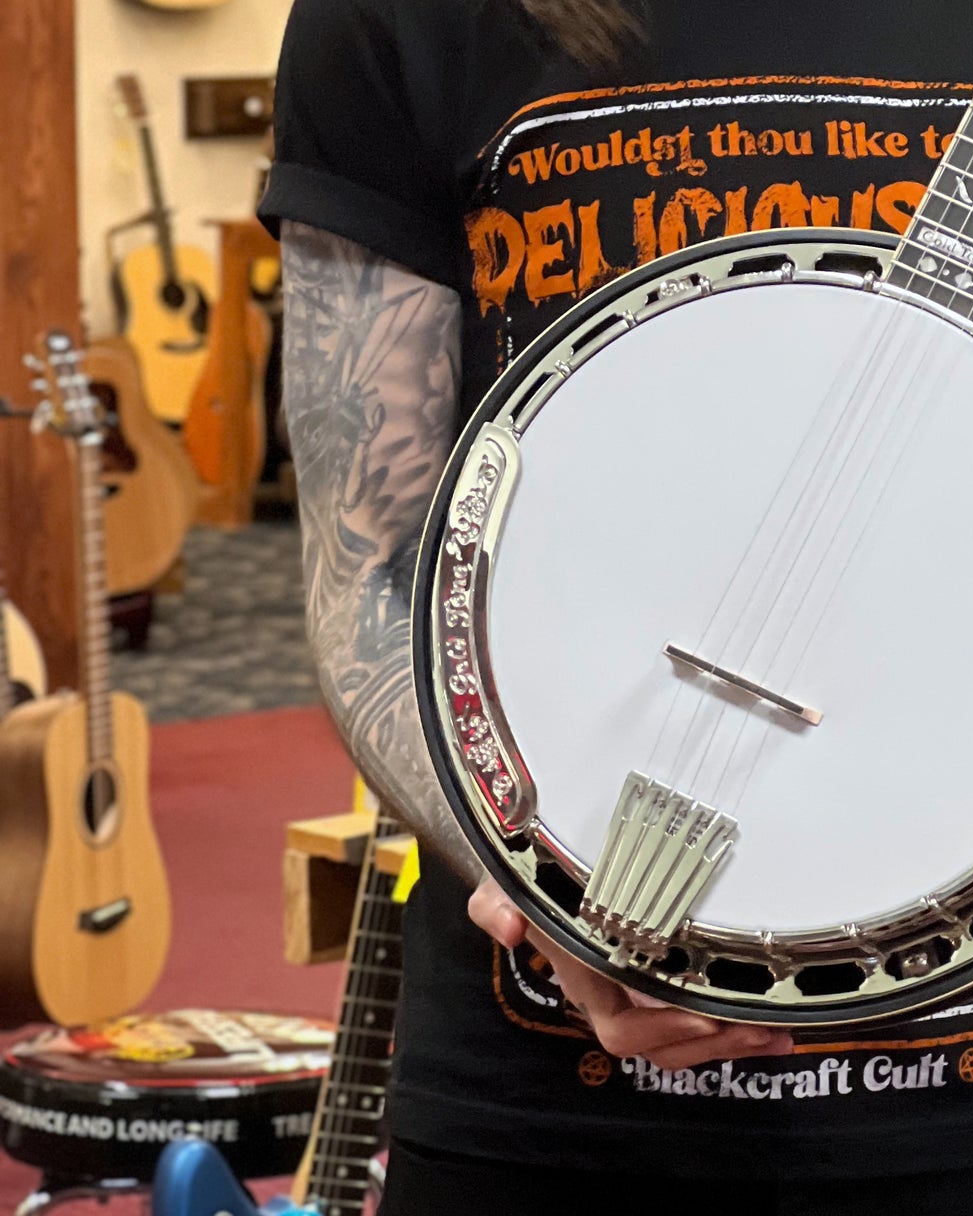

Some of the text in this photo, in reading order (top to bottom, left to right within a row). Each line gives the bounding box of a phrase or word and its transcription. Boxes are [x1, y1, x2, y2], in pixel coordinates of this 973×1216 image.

[508, 125, 707, 184] Wouldst
[707, 121, 813, 157] thou
[827, 120, 910, 159] like
[921, 230, 957, 254] Gold
[621, 1052, 950, 1100] Blackcraft Cult
[67, 1113, 115, 1140] AND
[116, 1117, 186, 1143] LONG
[195, 1119, 240, 1142] IFE
